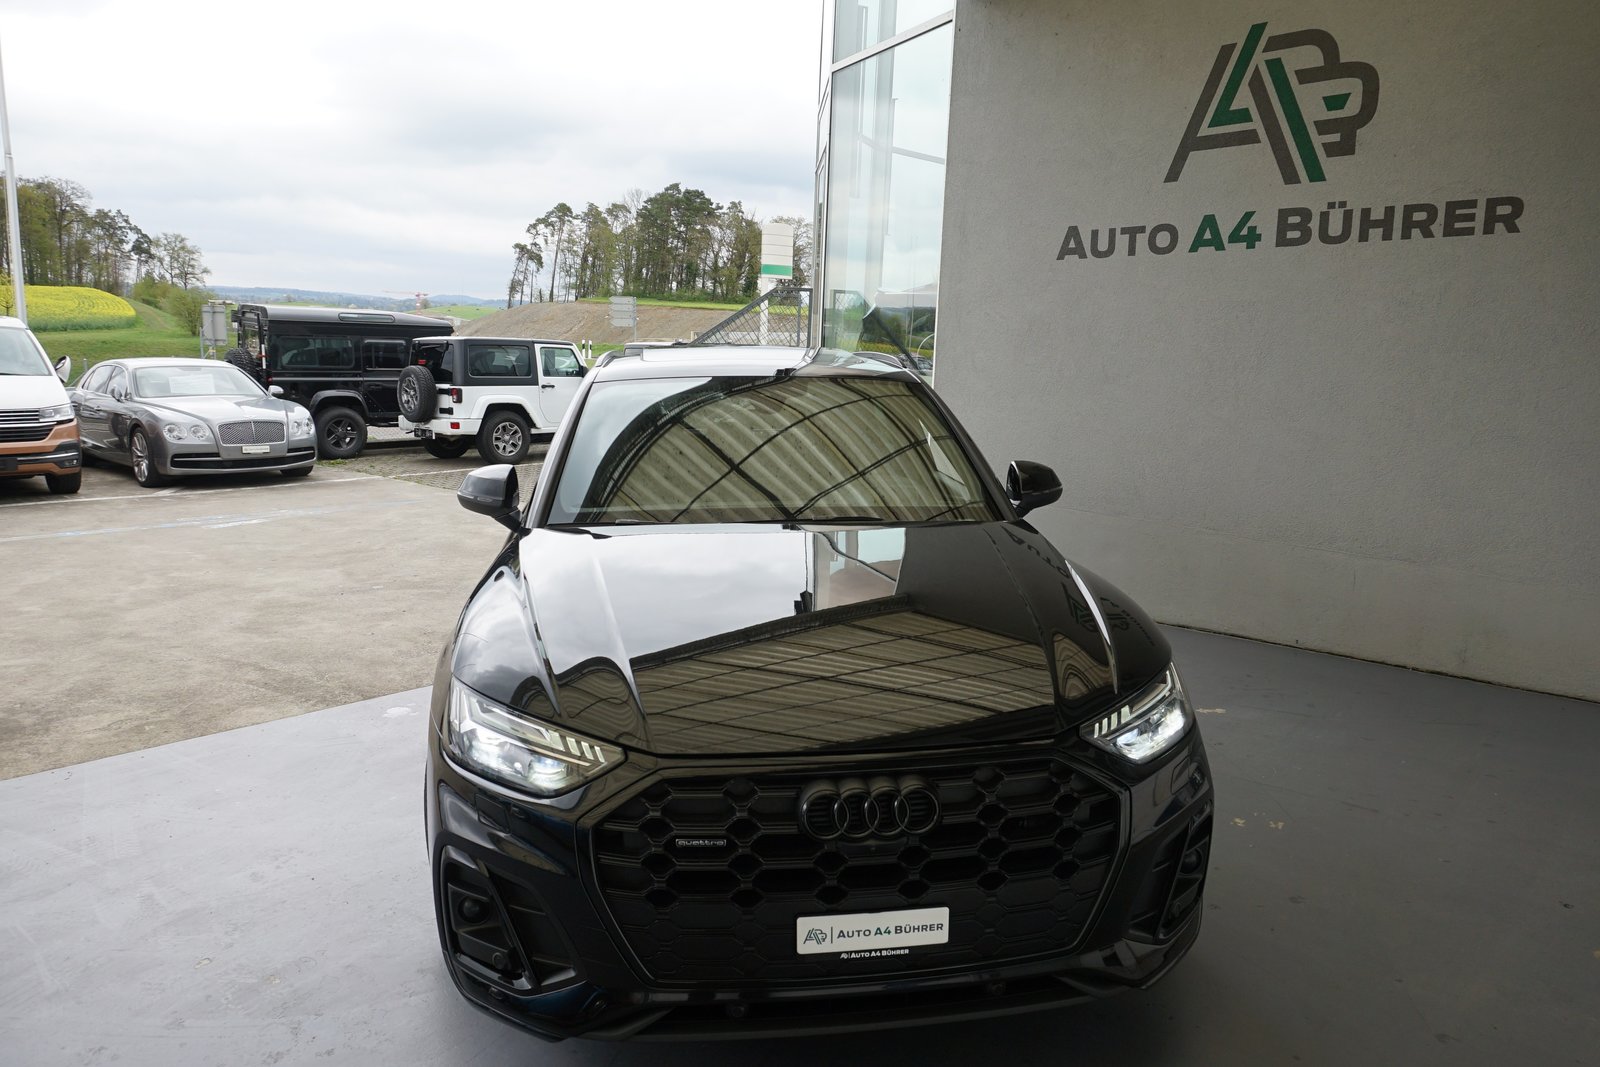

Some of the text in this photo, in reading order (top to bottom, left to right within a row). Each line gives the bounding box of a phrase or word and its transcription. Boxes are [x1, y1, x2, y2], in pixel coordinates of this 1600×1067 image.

[1056, 196, 1525, 261] AUTO A4 BÜHRER
[837, 929, 872, 939] AUTO
[874, 927, 892, 936] A4
[894, 923, 944, 935] BÜHRER
[881, 948, 910, 956] BÜHRER
